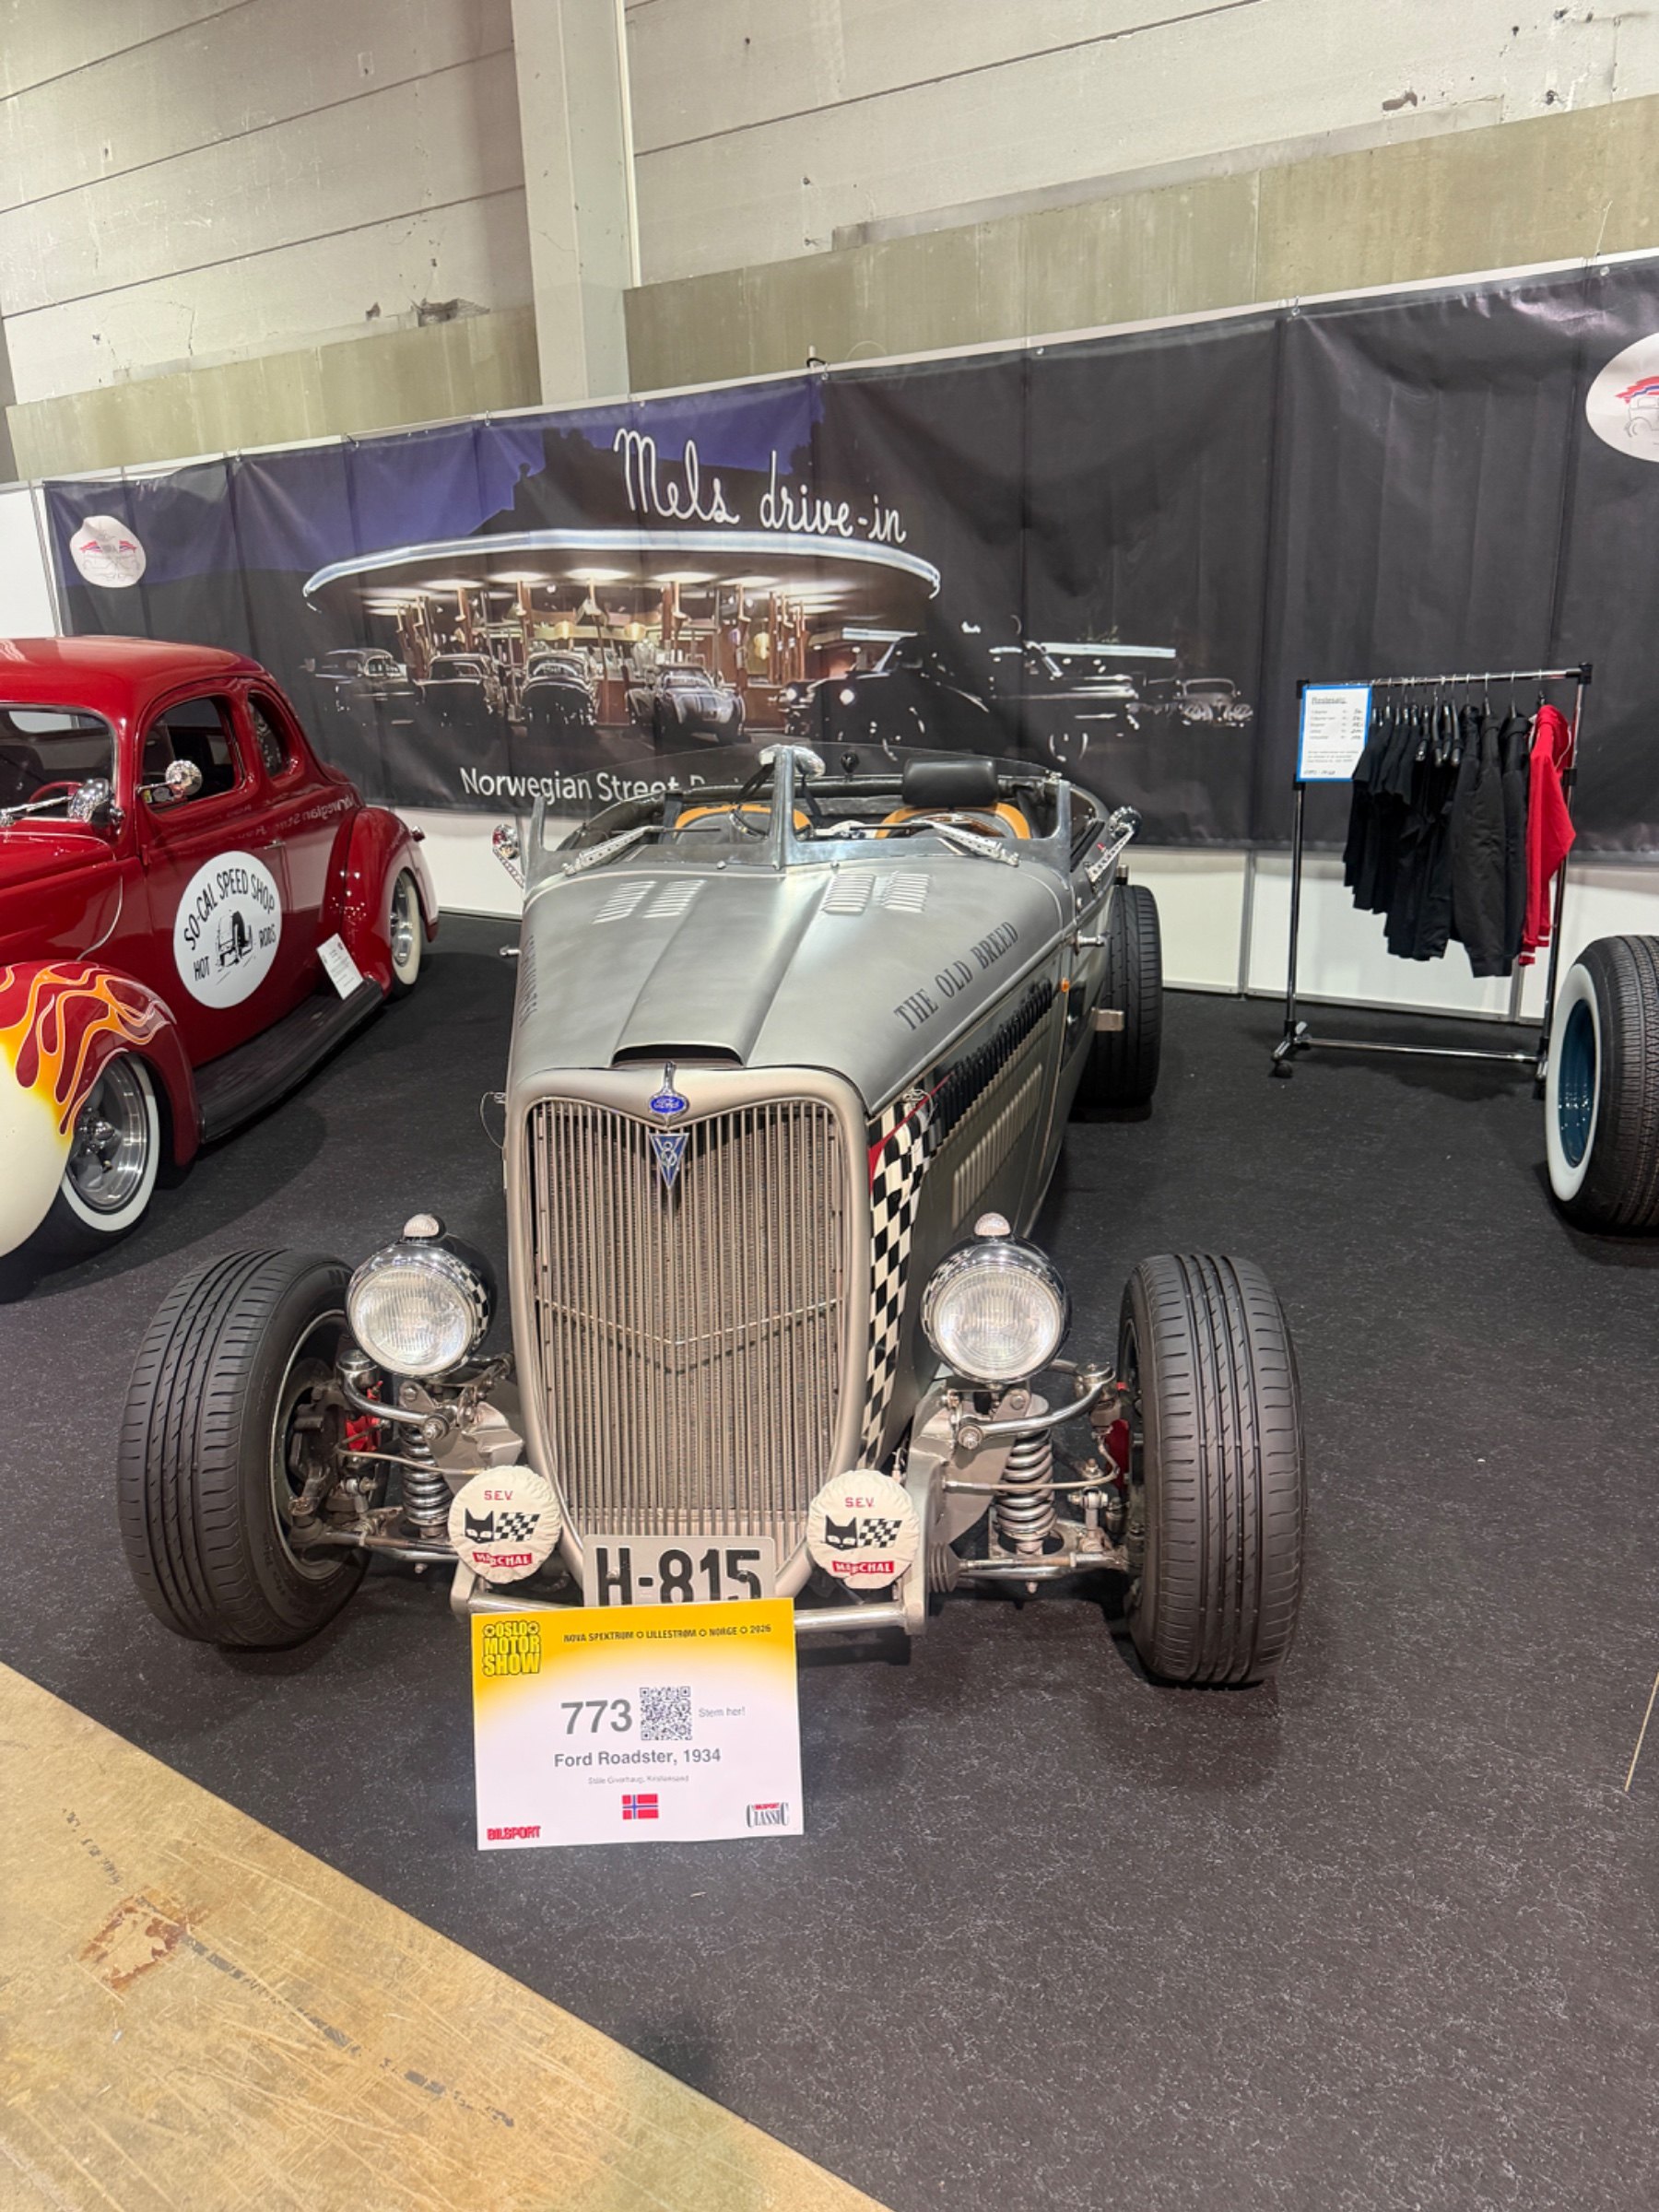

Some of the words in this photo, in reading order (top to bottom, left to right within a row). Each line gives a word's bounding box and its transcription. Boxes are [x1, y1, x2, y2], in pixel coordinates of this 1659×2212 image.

[614, 429, 739, 524] Mels
[760, 450, 906, 542] drive-in
[459, 767, 593, 805] Norwegian
[595, 771, 679, 801] Street
[184, 883, 218, 950] SO-CAL
[217, 868, 249, 900] SPEED
[251, 874, 275, 914] SHOP
[193, 956, 210, 981] HOT
[259, 924, 276, 949] RODS
[893, 987, 939, 1030] THE
[935, 959, 973, 998] OLD
[970, 922, 1018, 969] BREED
[596, 1547, 761, 1606] H-815
[495, 1620, 528, 1638] OSLO
[563, 1633, 586, 1642] NOVA
[588, 1631, 634, 1641] SPEKTRUM
[646, 1629, 697, 1639] LILLESTRØM
[709, 1627, 737, 1637] NORGE
[749, 1624, 771, 1633] 2026
[484, 1635, 541, 1655] MOTOR
[483, 1653, 541, 1677] SHOW
[560, 1699, 632, 1735] 773
[698, 1708, 724, 1718] Stem
[725, 1706, 746, 1716] her!
[554, 1752, 593, 1768] Ford
[598, 1749, 677, 1766] Roadster,
[684, 1748, 721, 1762] 1934
[487, 1825, 541, 1841] BILSPORT
